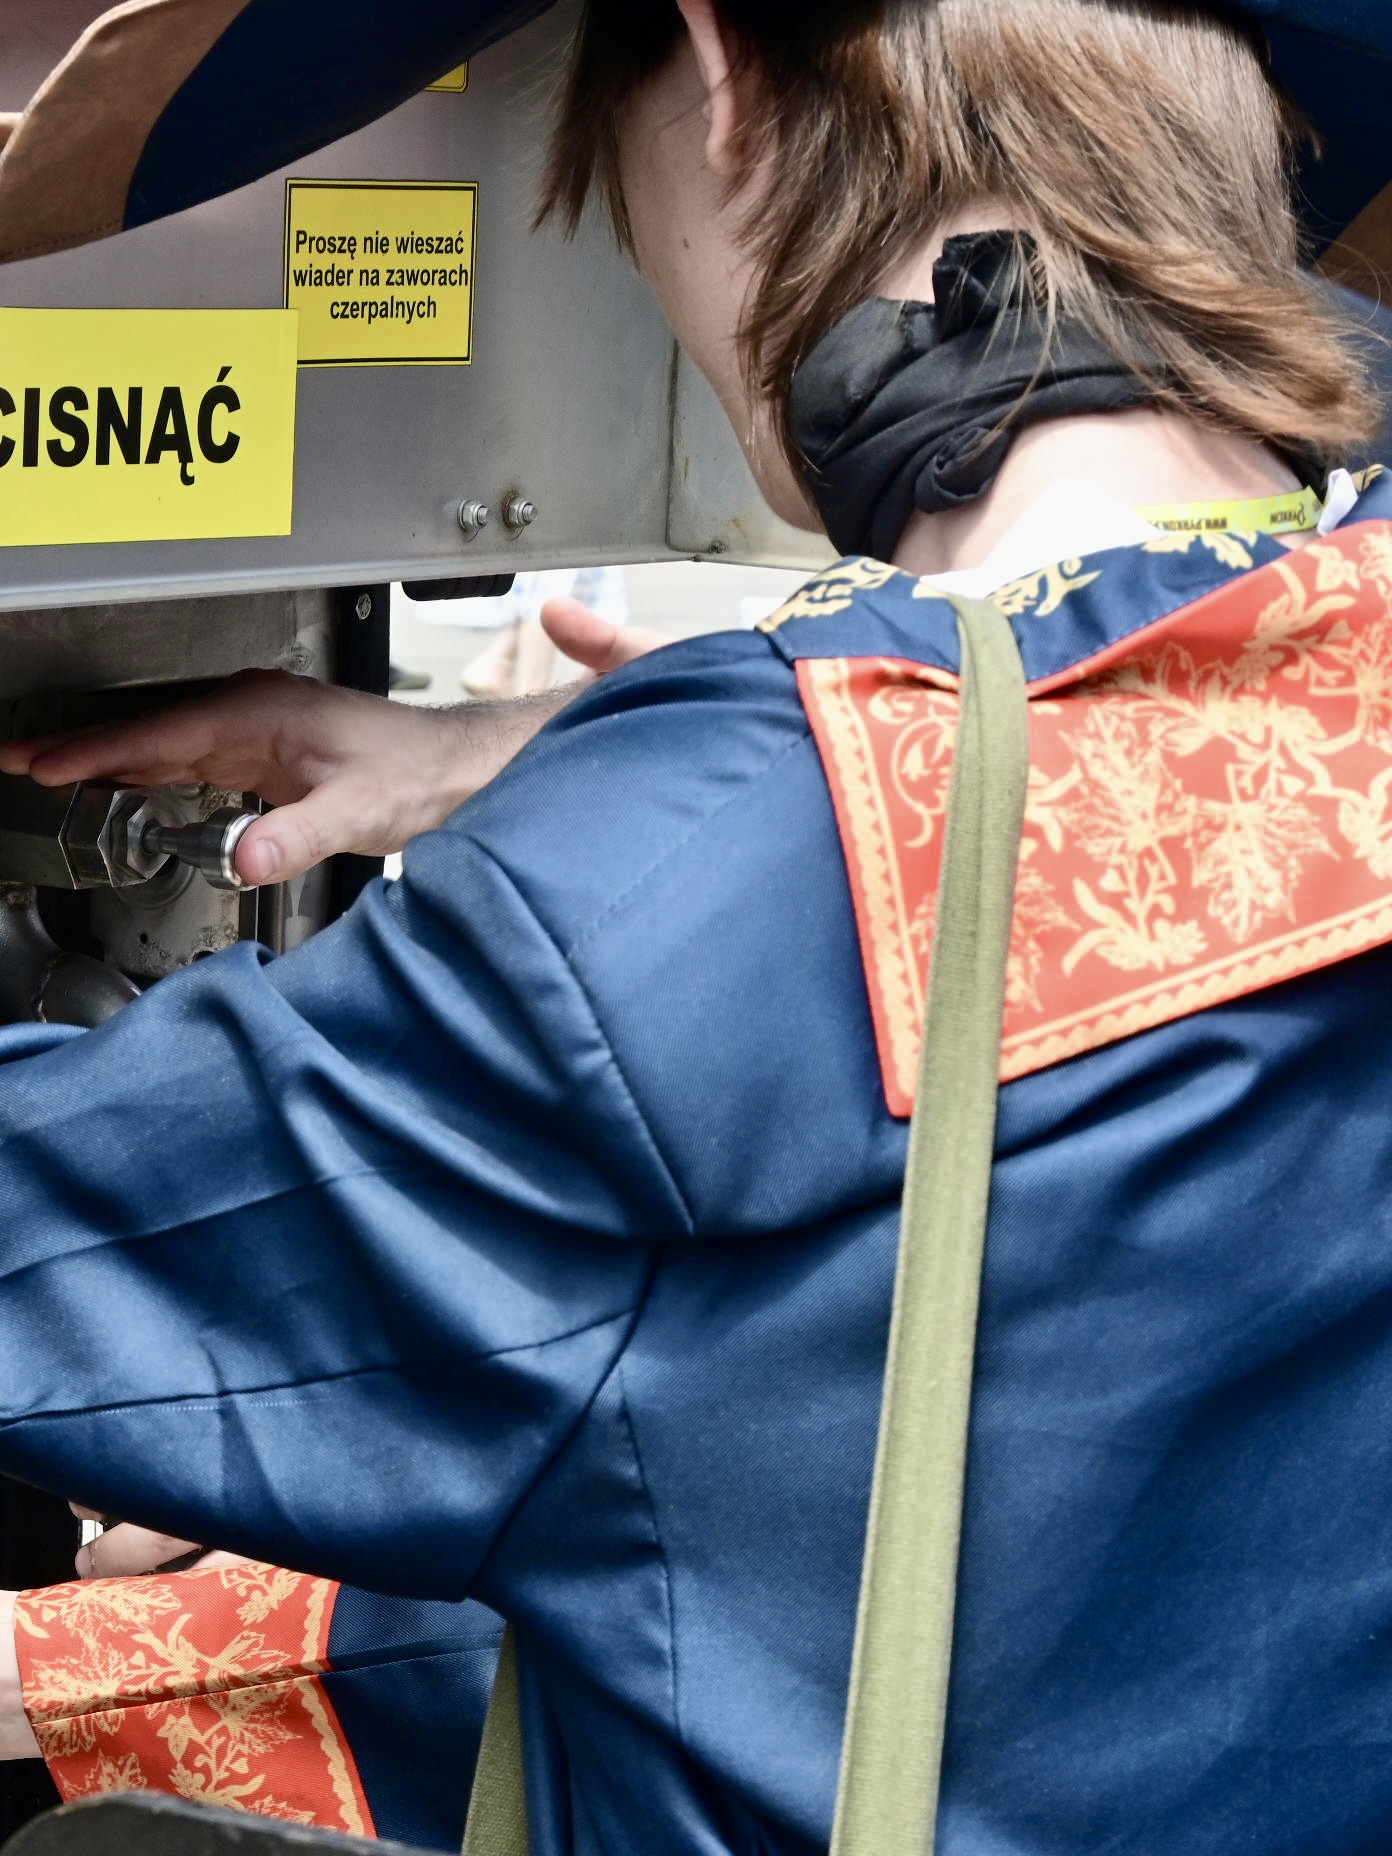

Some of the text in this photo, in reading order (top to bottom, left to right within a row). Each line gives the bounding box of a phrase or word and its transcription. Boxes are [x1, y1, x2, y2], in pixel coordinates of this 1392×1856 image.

[295, 230, 464, 260] Proszę nie wieszać
[293, 263, 468, 287] wiader na zaworach
[330, 295, 437, 325] czerpalnych
